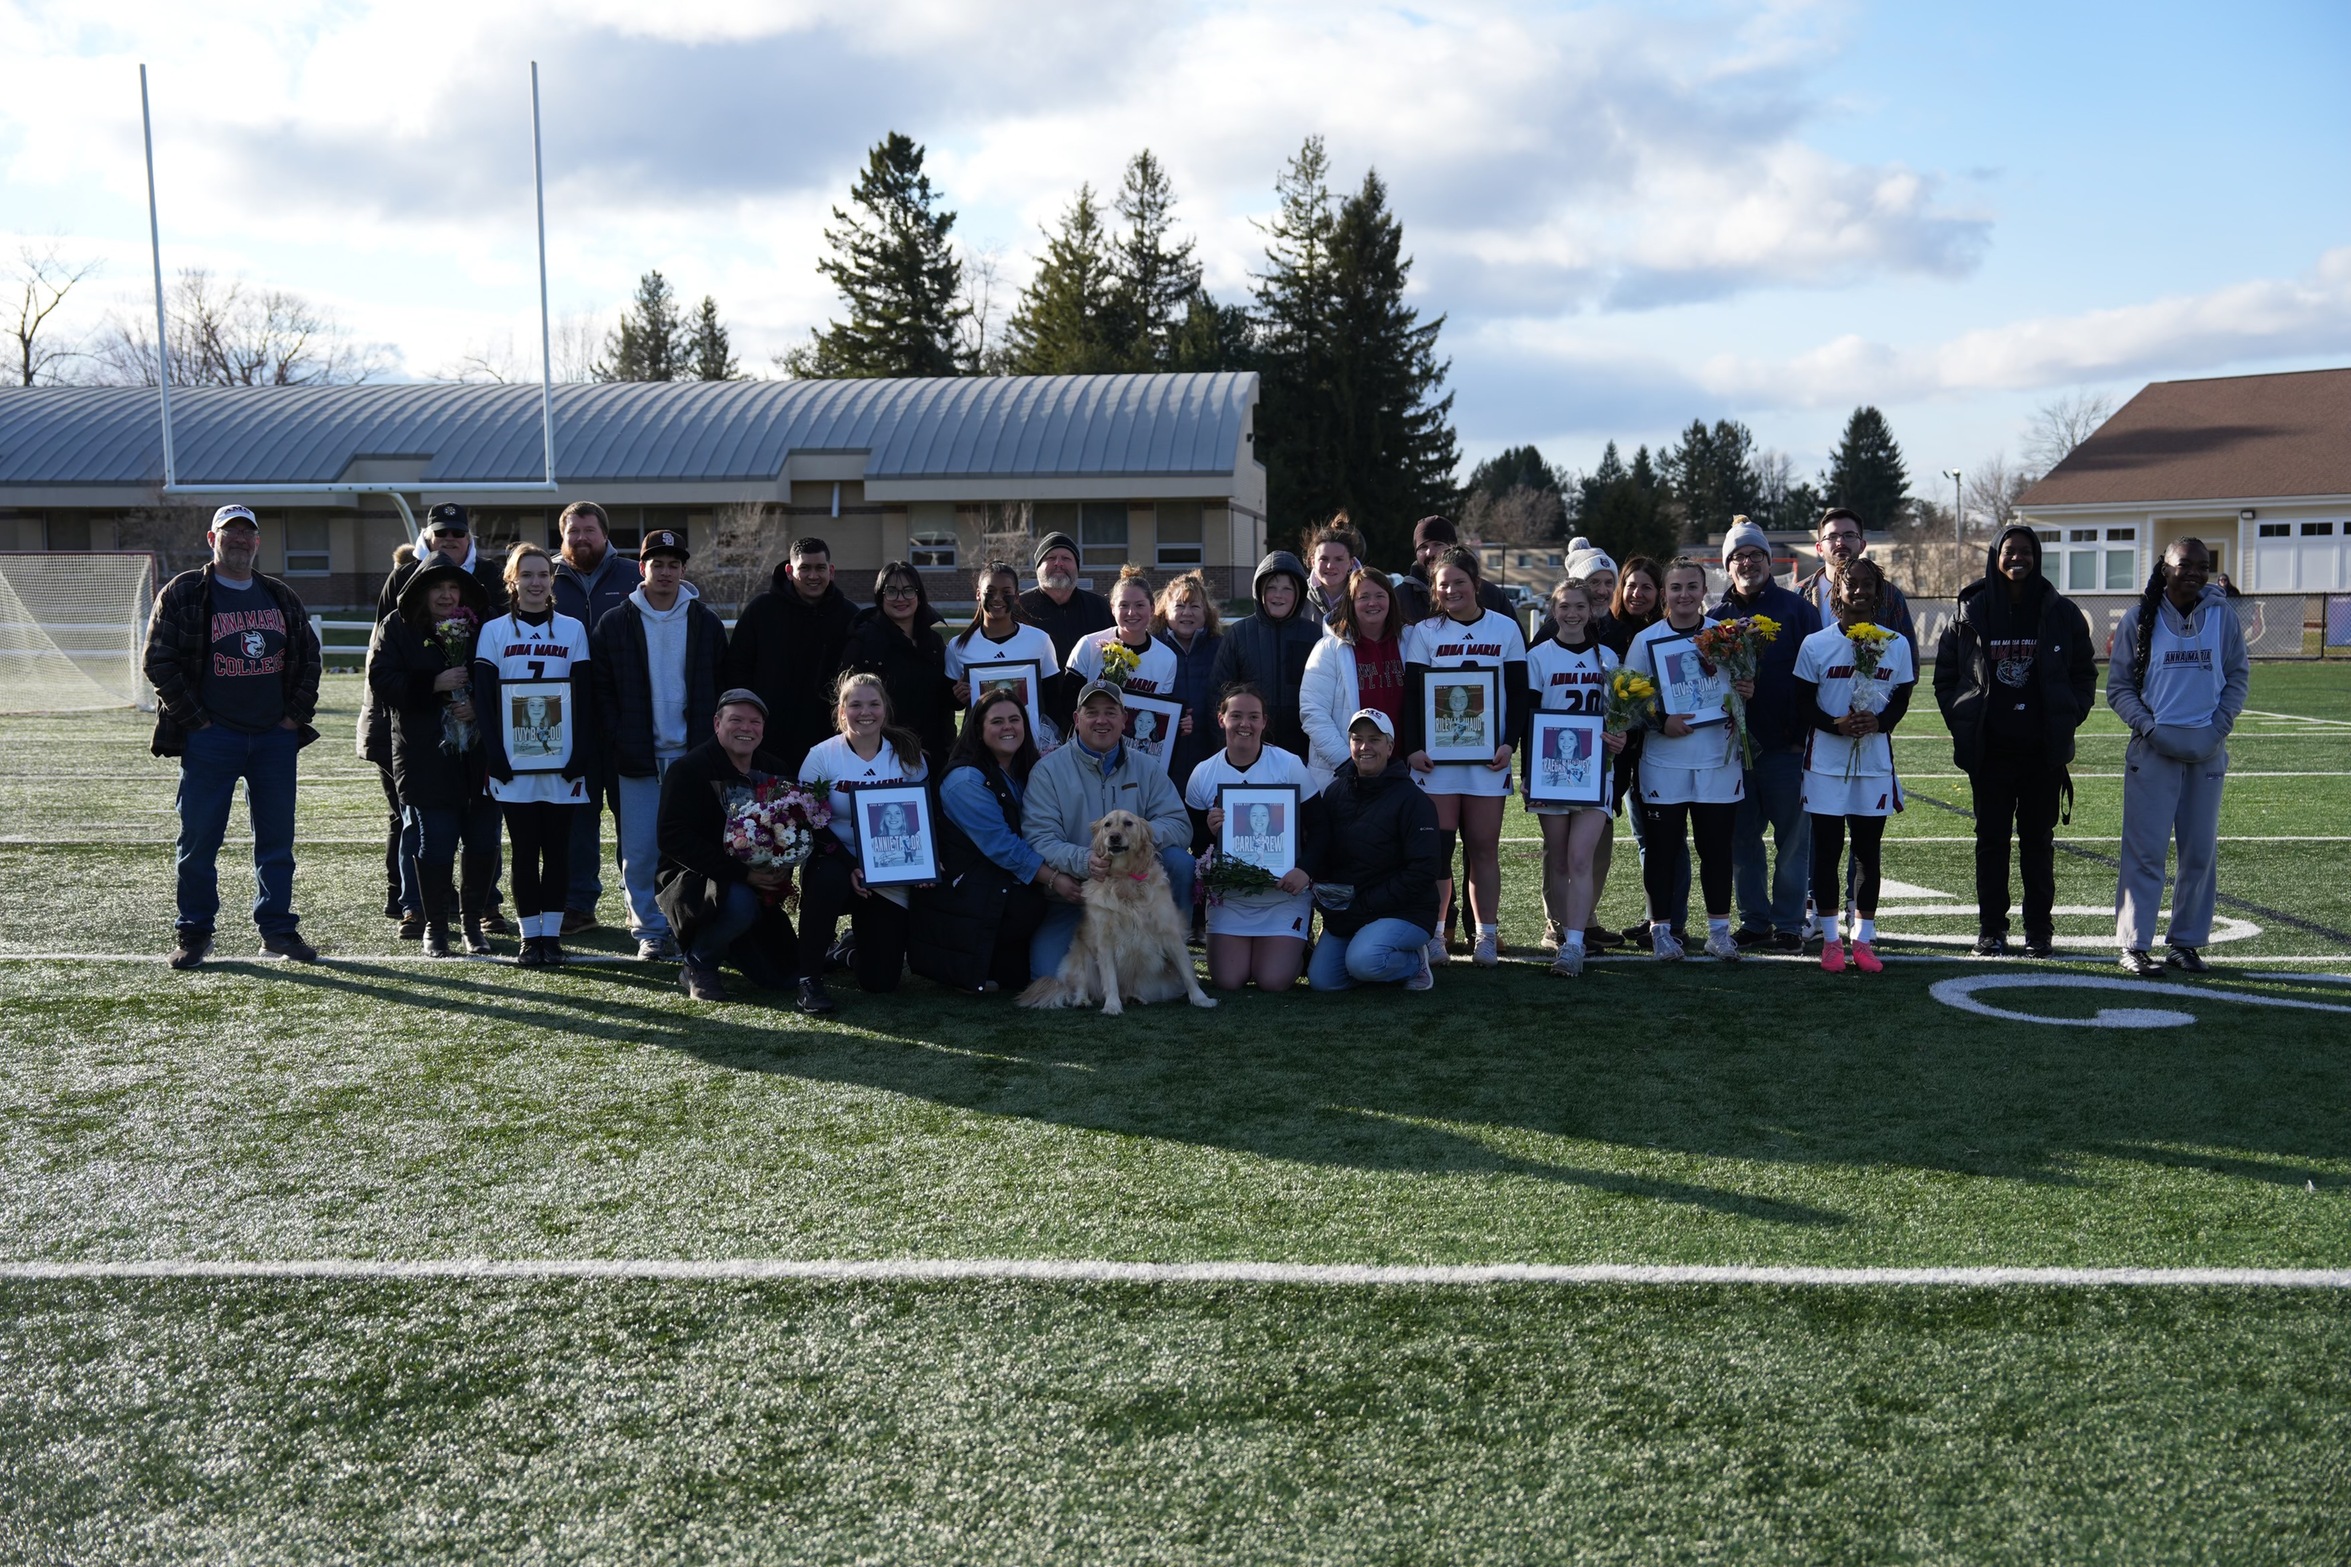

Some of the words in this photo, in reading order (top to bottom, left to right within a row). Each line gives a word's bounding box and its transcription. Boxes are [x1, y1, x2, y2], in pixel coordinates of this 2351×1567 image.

[211, 611, 246, 644] ANNA
[245, 608, 288, 639] MARIA
[504, 643, 532, 658] ANNA
[533, 643, 570, 659] MARIA
[1436, 644, 1465, 657] ANNA
[1465, 644, 1502, 657] MARIA
[2165, 650, 2184, 663] ANNA
[2186, 649, 2211, 662] MARIA
[527, 660, 545, 680] 7
[1357, 661, 1378, 678] NNA
[1874, 667, 1894, 681] RIA
[1550, 672, 1579, 687] ANNA
[1580, 672, 1604, 686] MAR
[1671, 681, 1687, 698] LIV
[1687, 676, 1718, 696] SUMP
[1565, 688, 1601, 712] 20
[1435, 717, 1454, 732] RILEY
[514, 727, 529, 742] IVY
[529, 726, 562, 741] BOU
[872, 836, 896, 852] ANNIE
[895, 834, 922, 851] TALOR
[1234, 835, 1257, 852] CARLY
[1258, 835, 1284, 852] REW
